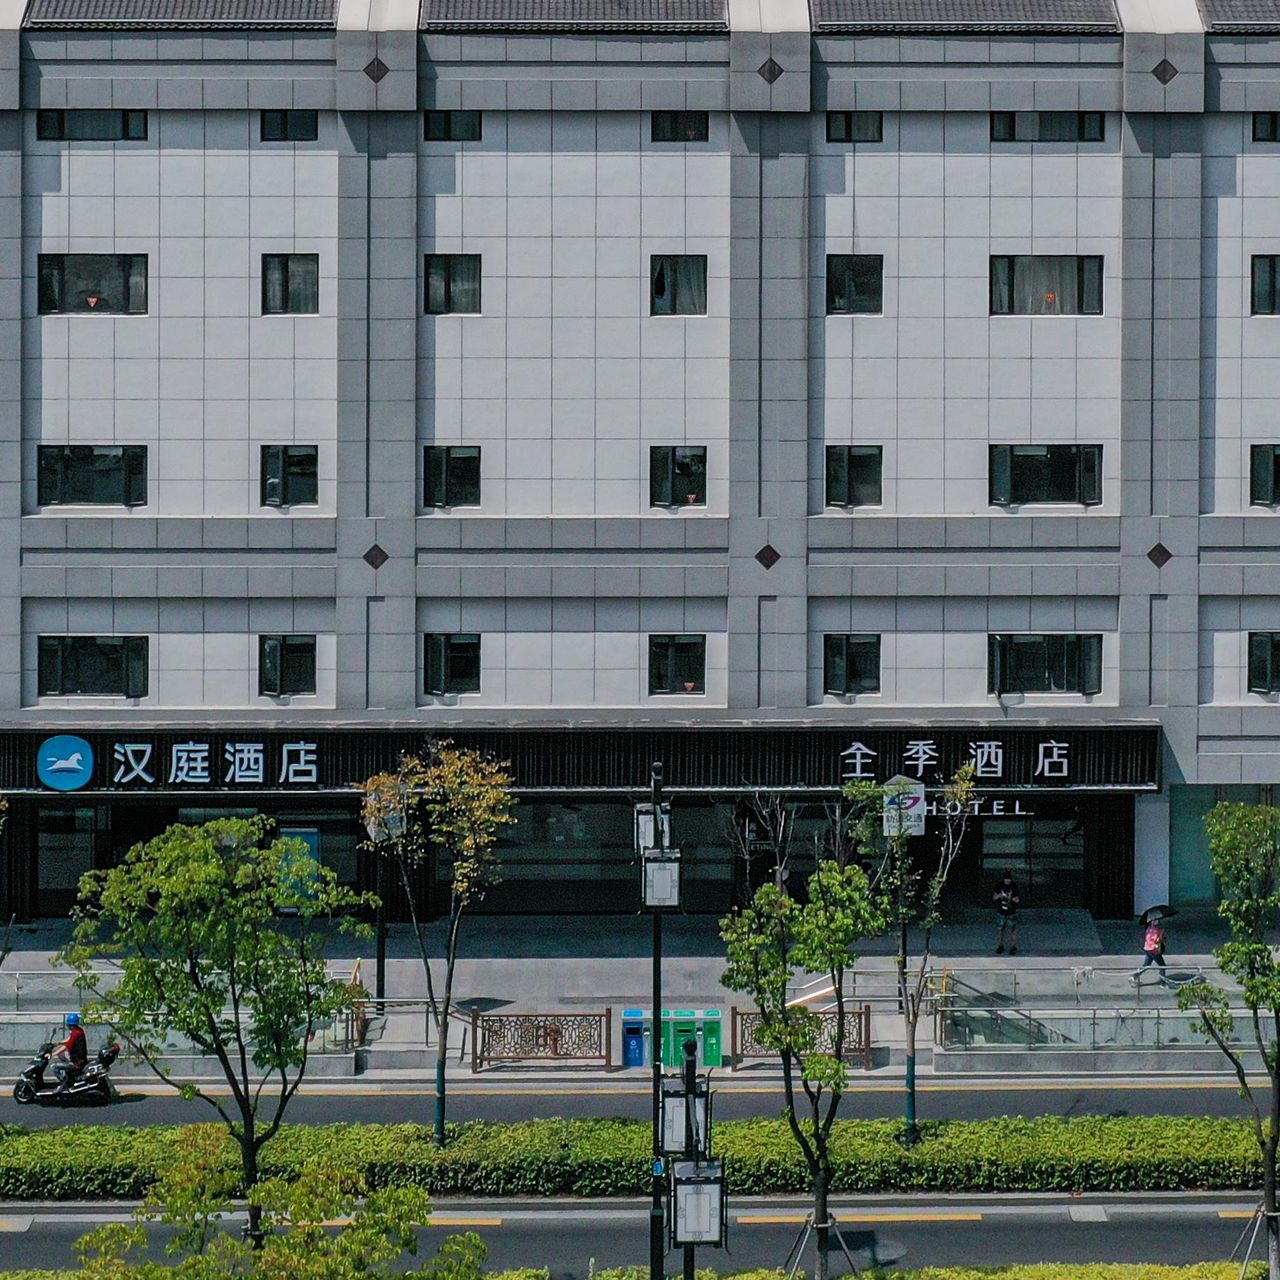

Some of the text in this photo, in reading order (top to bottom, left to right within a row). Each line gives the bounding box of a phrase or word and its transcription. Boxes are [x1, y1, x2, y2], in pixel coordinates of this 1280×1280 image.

[113, 741, 318, 783] 汉庭酒店
[840, 740, 1070, 777] 全季酒店
[924, 800, 1027, 815] HOTEL
